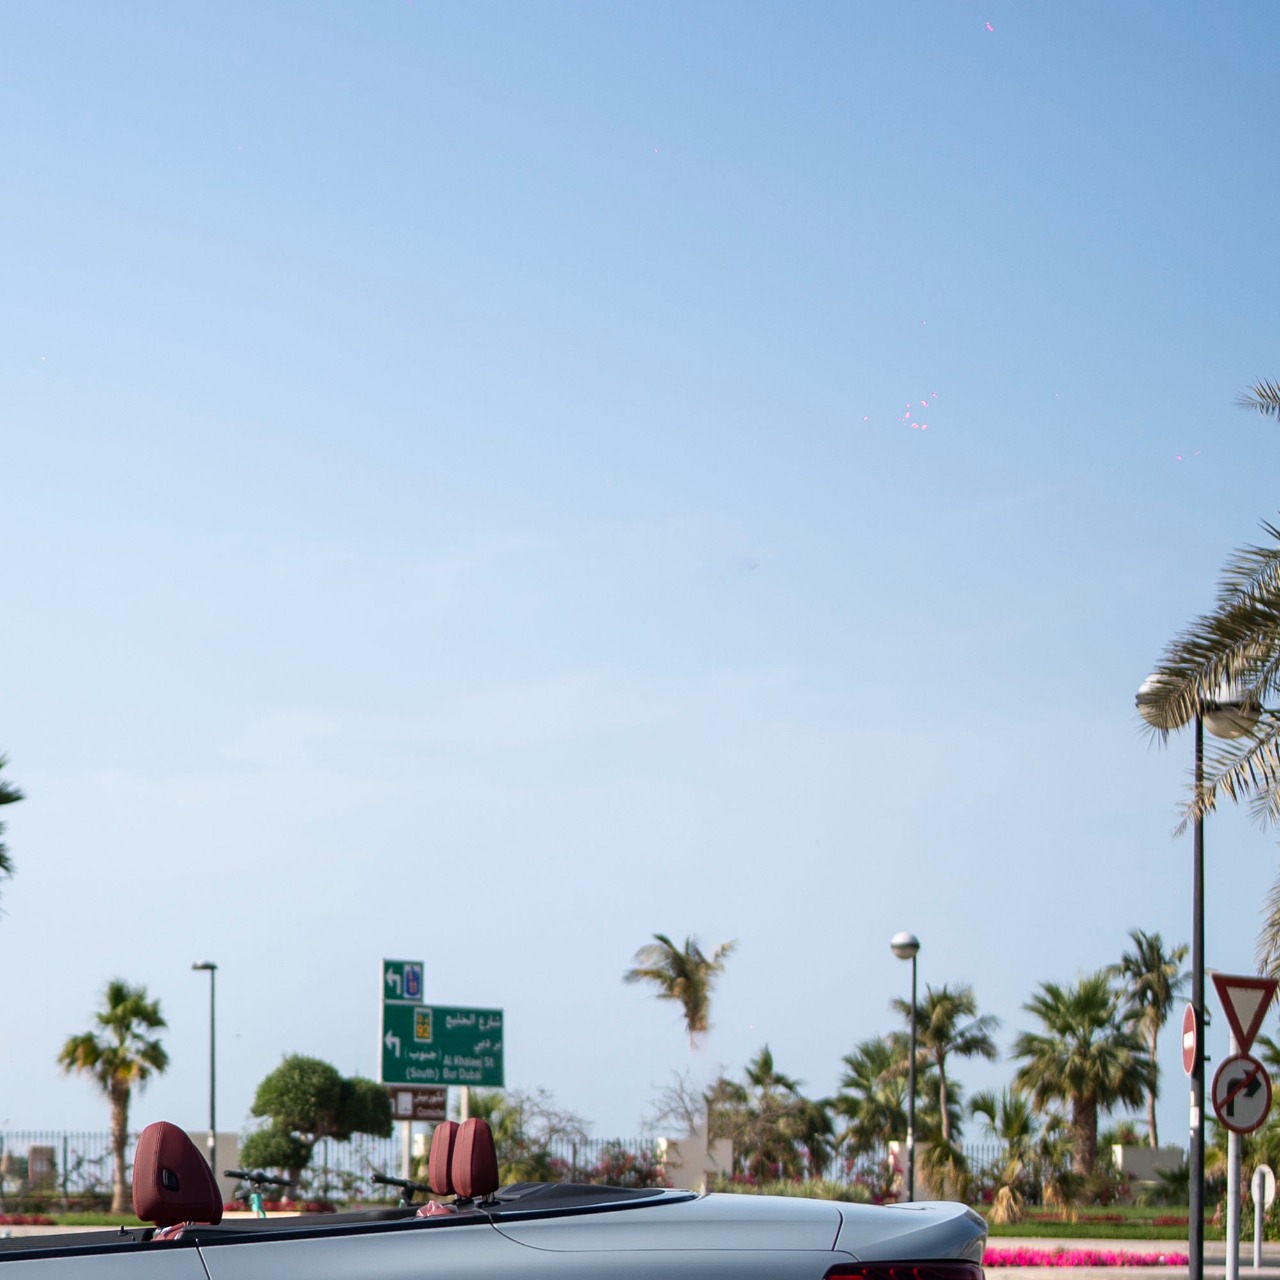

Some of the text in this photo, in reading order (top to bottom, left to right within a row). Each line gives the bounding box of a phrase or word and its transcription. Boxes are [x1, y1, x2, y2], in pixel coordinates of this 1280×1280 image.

[417, 1024, 430, 1037] 92
[454, 1055, 483, 1069] Khaleej
[406, 1067, 439, 1081] (South)
[443, 1067, 483, 1080] Bur Dubai
